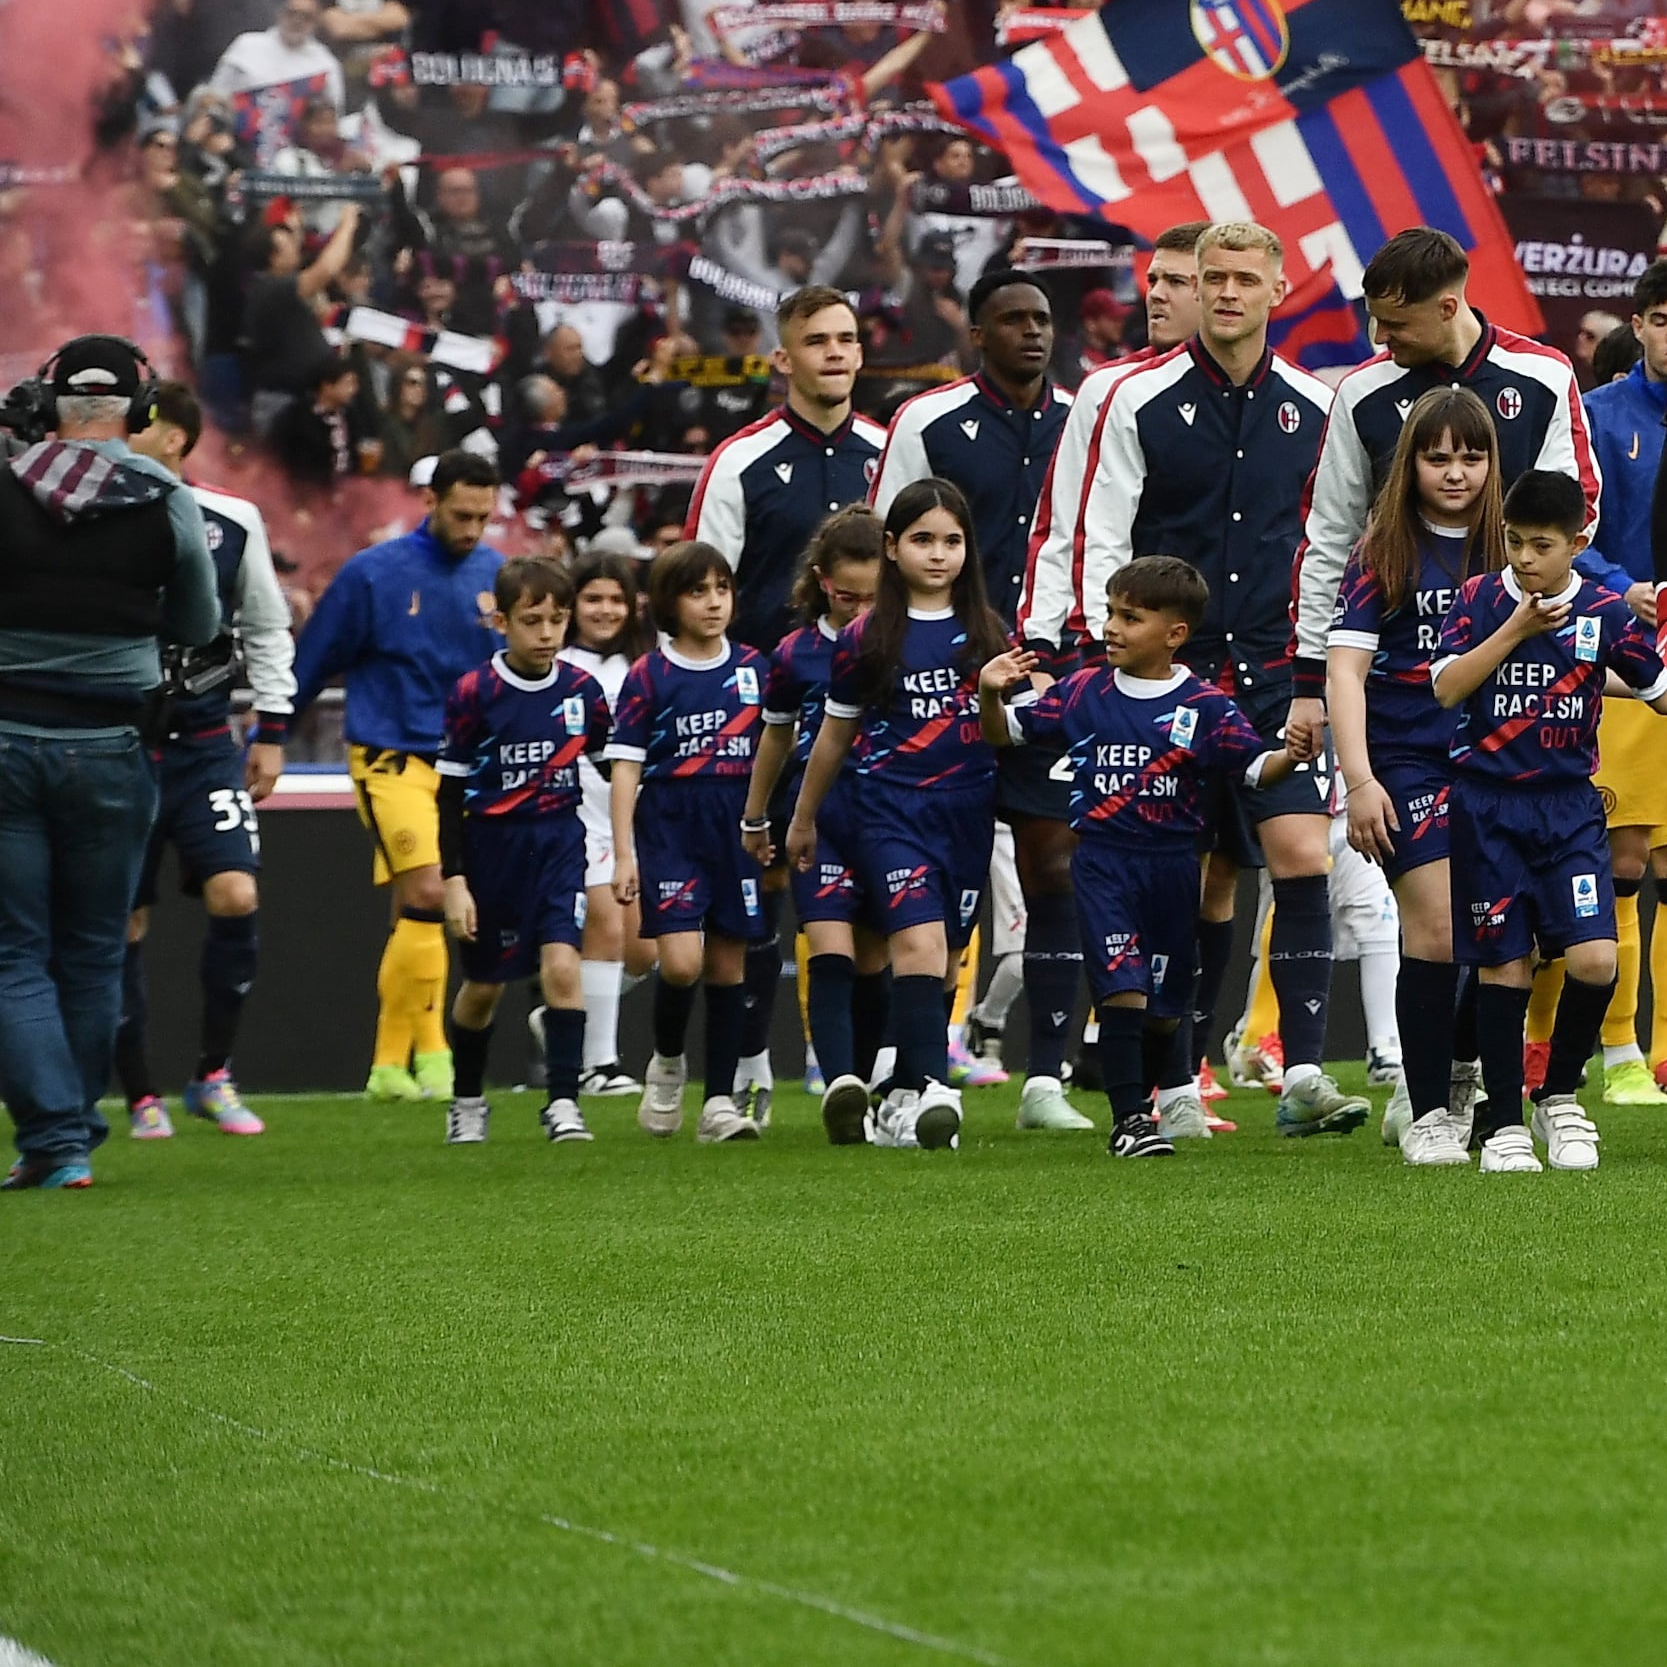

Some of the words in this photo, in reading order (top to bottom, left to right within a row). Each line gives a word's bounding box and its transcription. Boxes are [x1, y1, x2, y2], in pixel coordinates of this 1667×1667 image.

[1495, 661, 1557, 687] KEEP
[1492, 692, 1585, 719] RACISM
[675, 710, 727, 738] KEEP
[500, 739, 556, 765] KEEP
[1096, 745, 1152, 768] KEEP
[1094, 772, 1179, 798] RACISM
